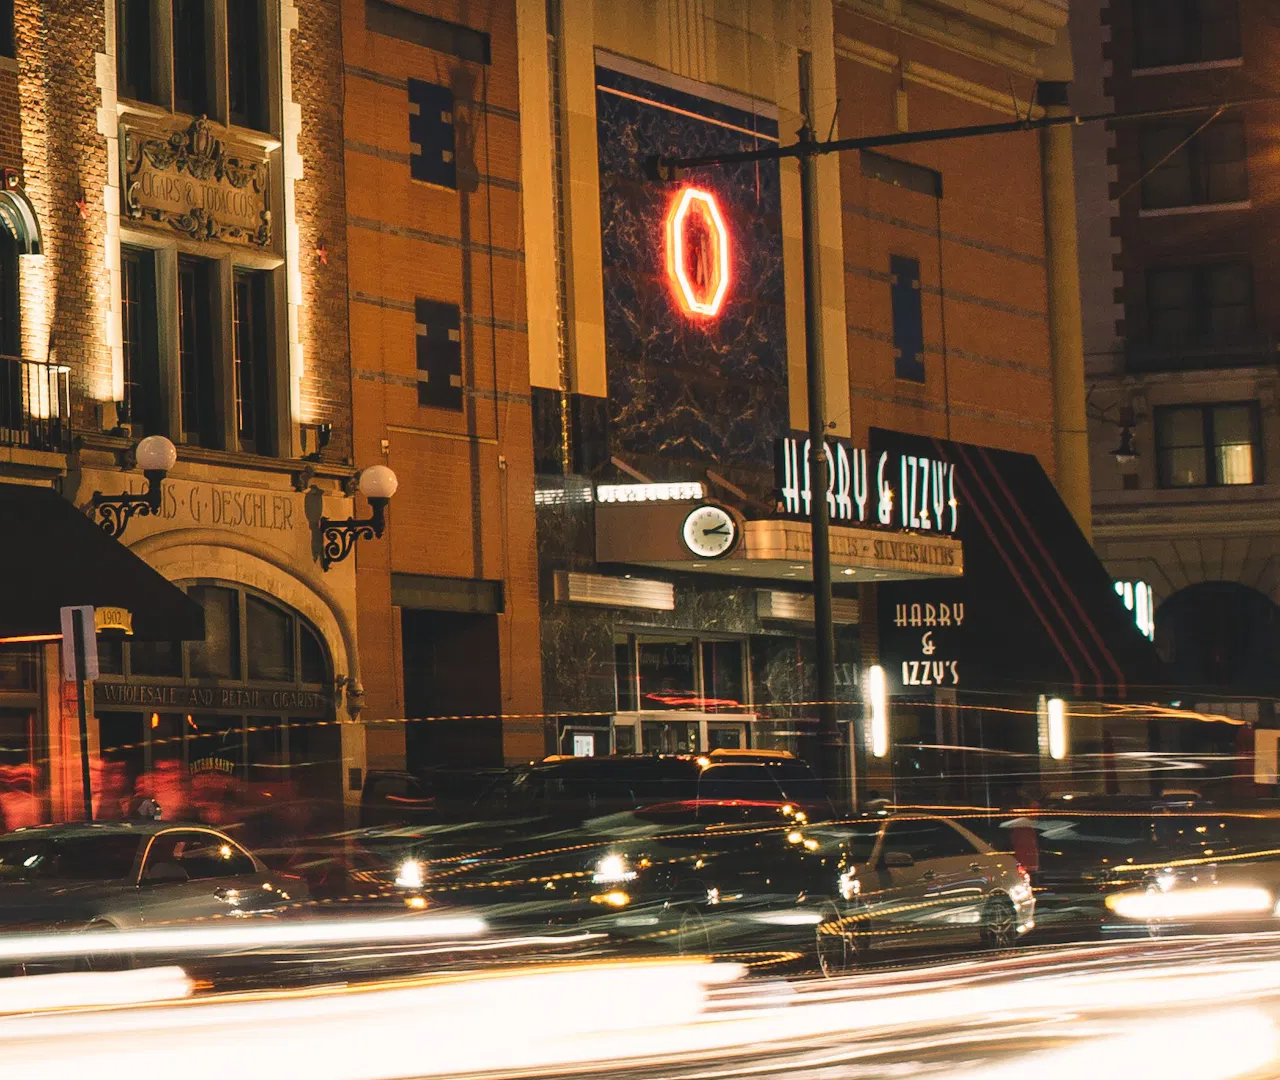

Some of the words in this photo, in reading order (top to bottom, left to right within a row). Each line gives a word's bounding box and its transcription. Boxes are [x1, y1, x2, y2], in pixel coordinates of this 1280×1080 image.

[141, 171, 181, 203] CIGARS
[201, 184, 255, 219] TOBACCOS
[877, 450, 893, 525] &
[901, 454, 958, 533] IZZY'S
[212, 487, 293, 531] DESCHLER
[102, 610, 122, 625] 1902
[894, 603, 965, 626] HARRY
[921, 631, 936, 655] &
[902, 661, 959, 686] IZZY'S
[104, 684, 176, 704] WHOLESALE
[190, 688, 213, 705] AND
[222, 689, 260, 707] RETAIL
